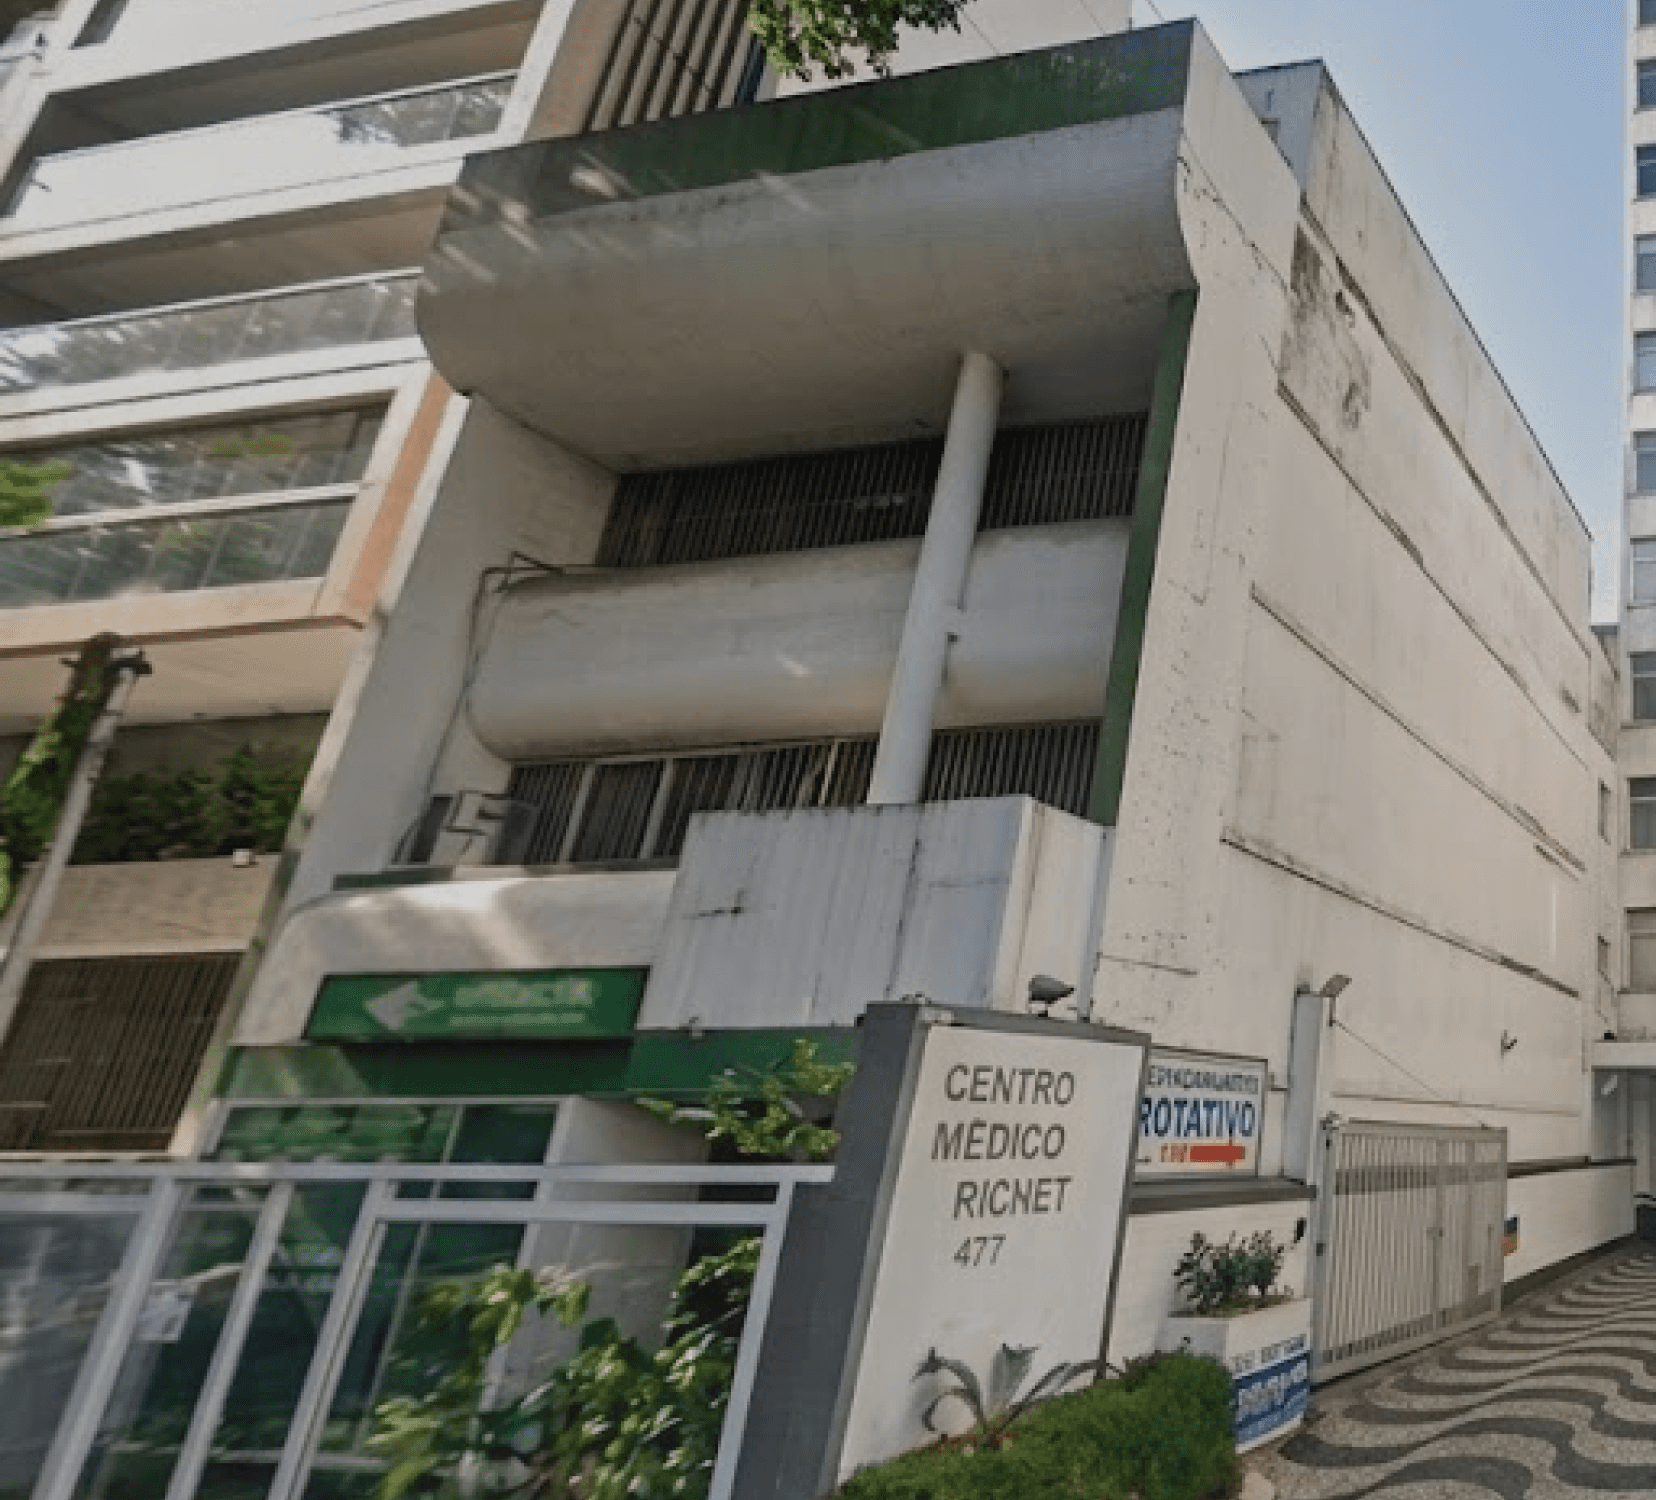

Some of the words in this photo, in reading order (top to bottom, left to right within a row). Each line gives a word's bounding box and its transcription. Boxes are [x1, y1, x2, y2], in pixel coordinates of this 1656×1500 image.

[944, 1063, 1075, 1106] CENTRO
[1141, 1097, 1256, 1137] ROTATIVO
[931, 1116, 1066, 1160] MÉDICO
[953, 1234, 1006, 1267] 477
